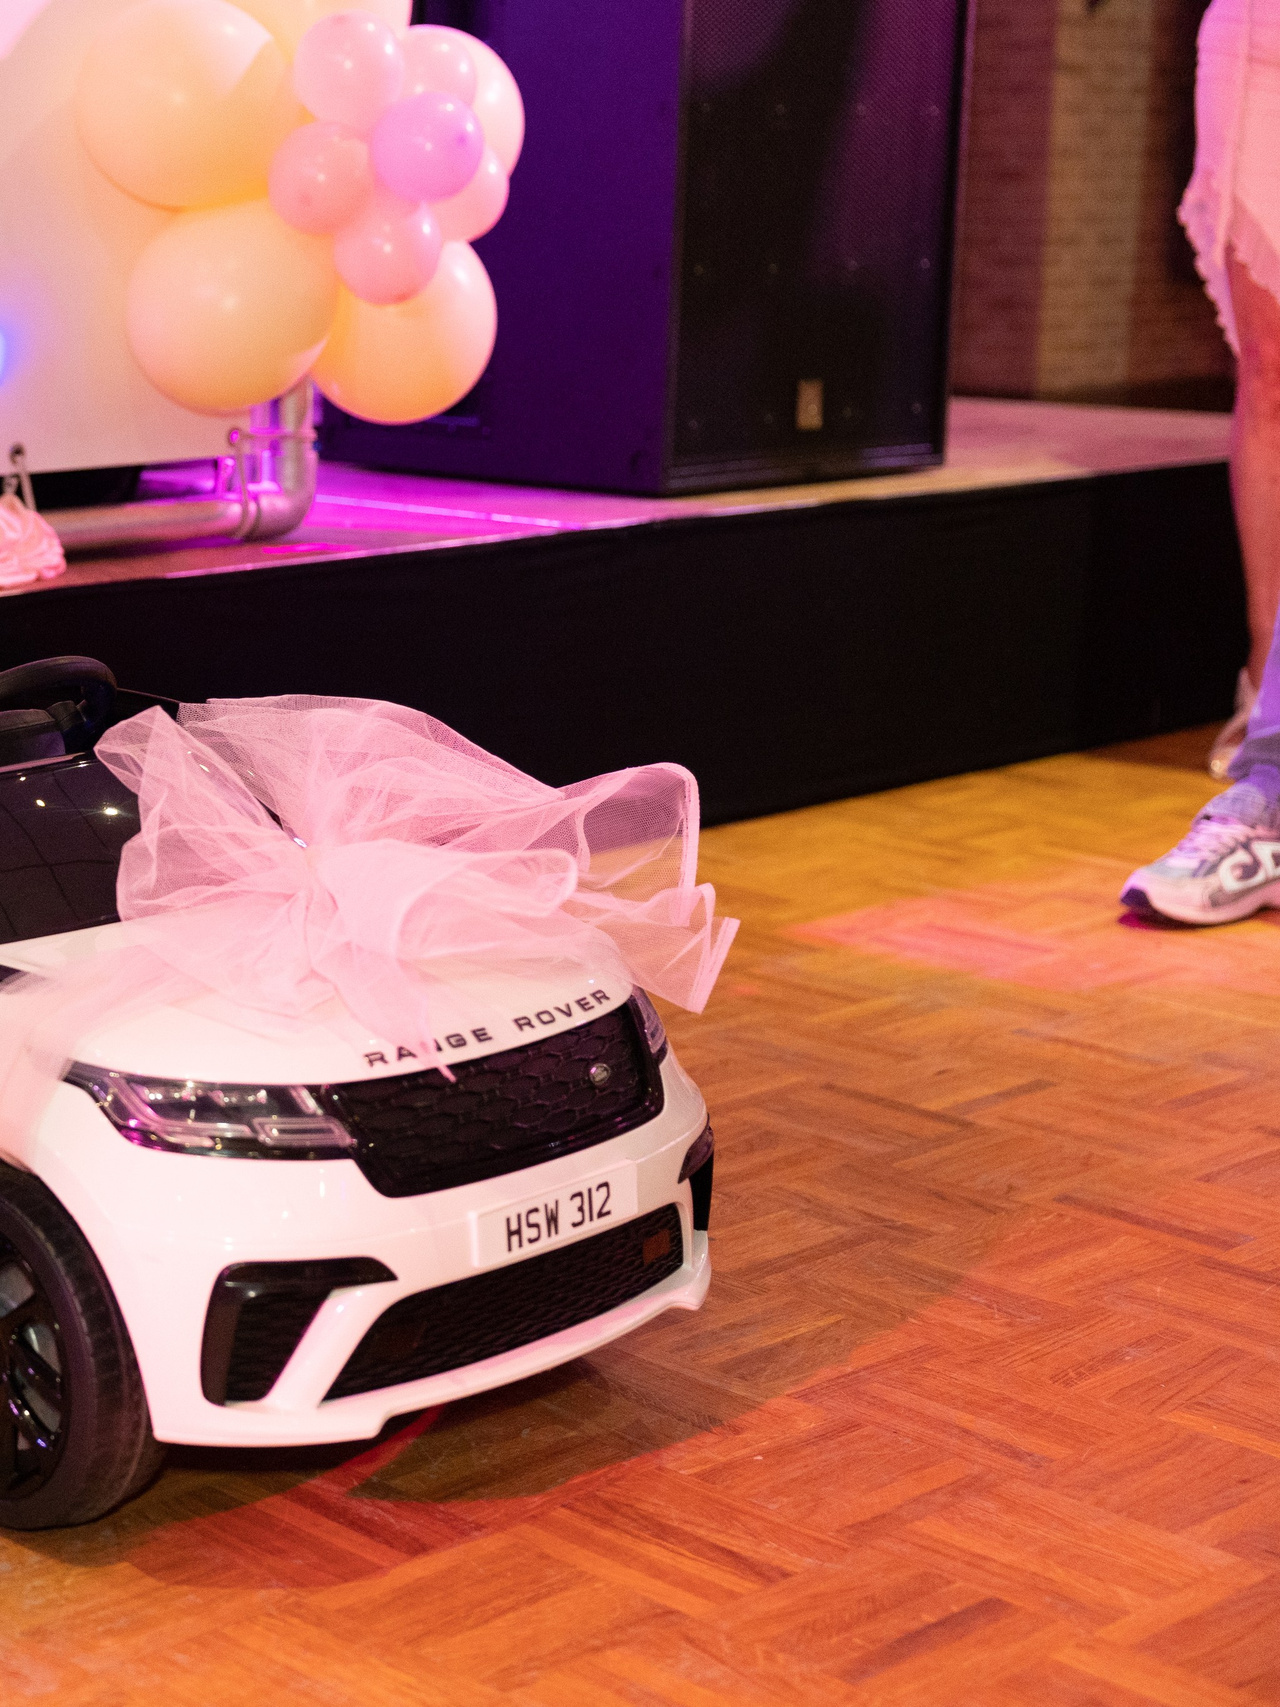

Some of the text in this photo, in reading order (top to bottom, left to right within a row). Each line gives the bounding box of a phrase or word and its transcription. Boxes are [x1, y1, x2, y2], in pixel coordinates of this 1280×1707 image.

[512, 989, 611, 1032] ROVER
[505, 1181, 612, 1252] HSW 312
